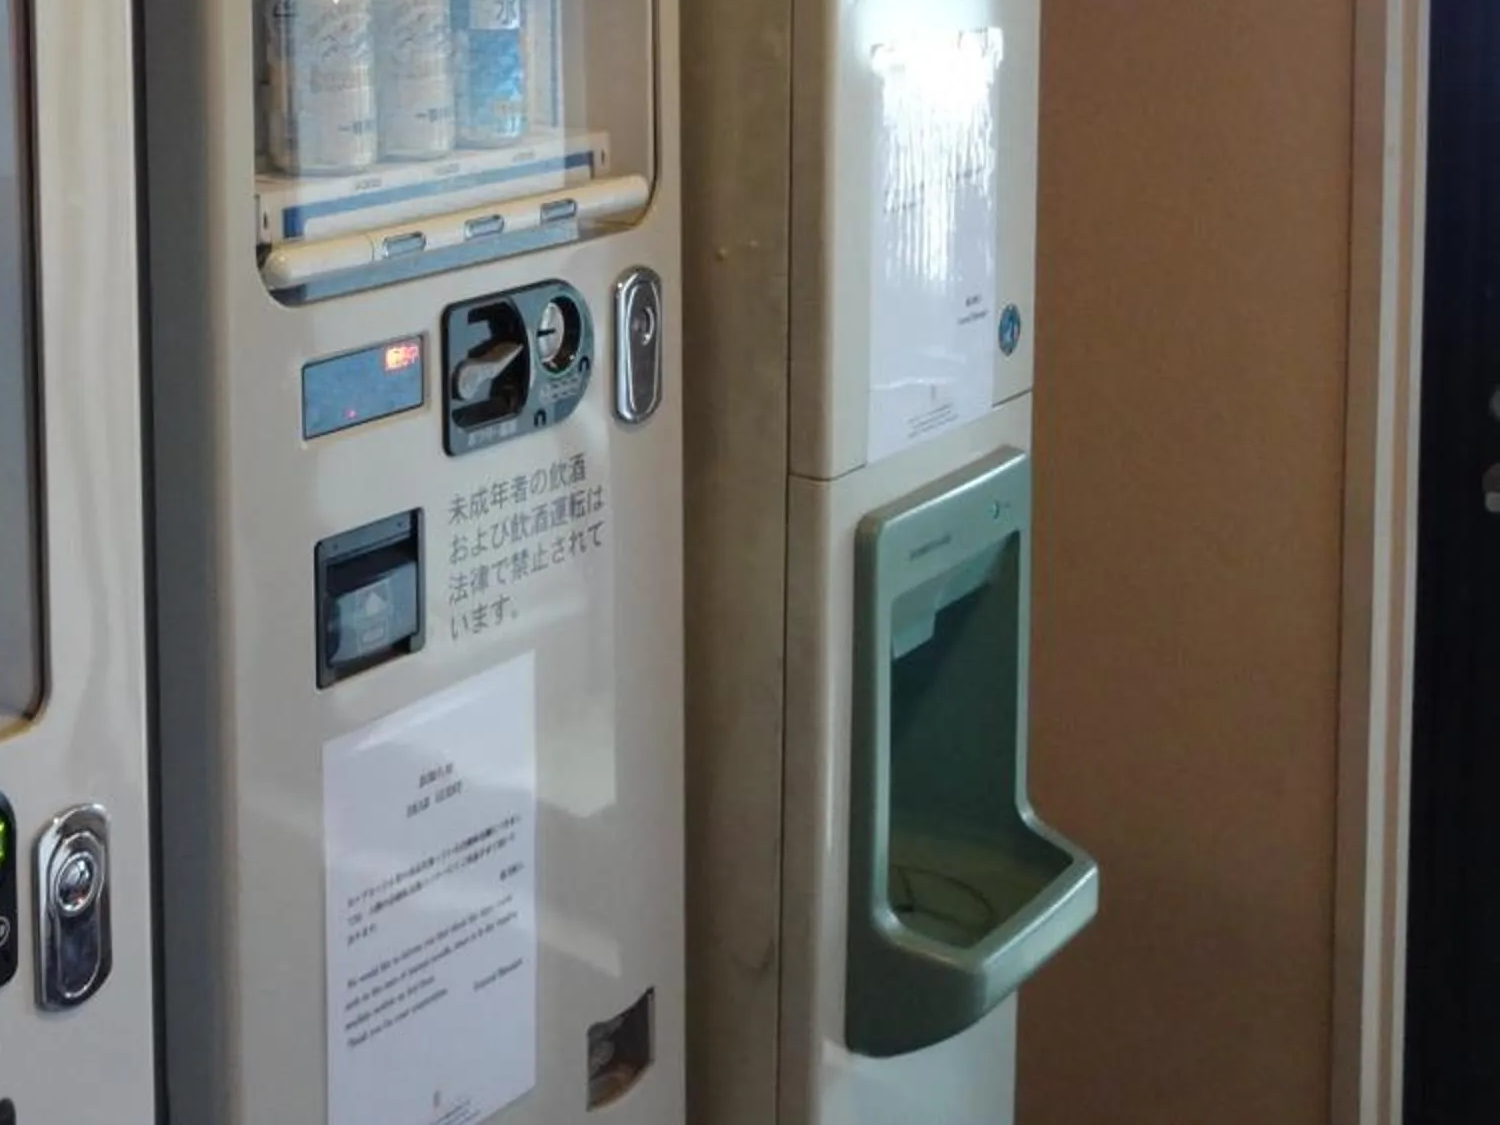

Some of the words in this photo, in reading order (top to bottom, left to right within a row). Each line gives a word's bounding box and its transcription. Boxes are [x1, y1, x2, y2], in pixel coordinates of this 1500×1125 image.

[448, 452, 586, 525] 未成年者の飲酒
[449, 485, 605, 567] および飲酒運転は
[448, 521, 606, 606] 法律で禁止されて
[450, 597, 519, 641] います。
